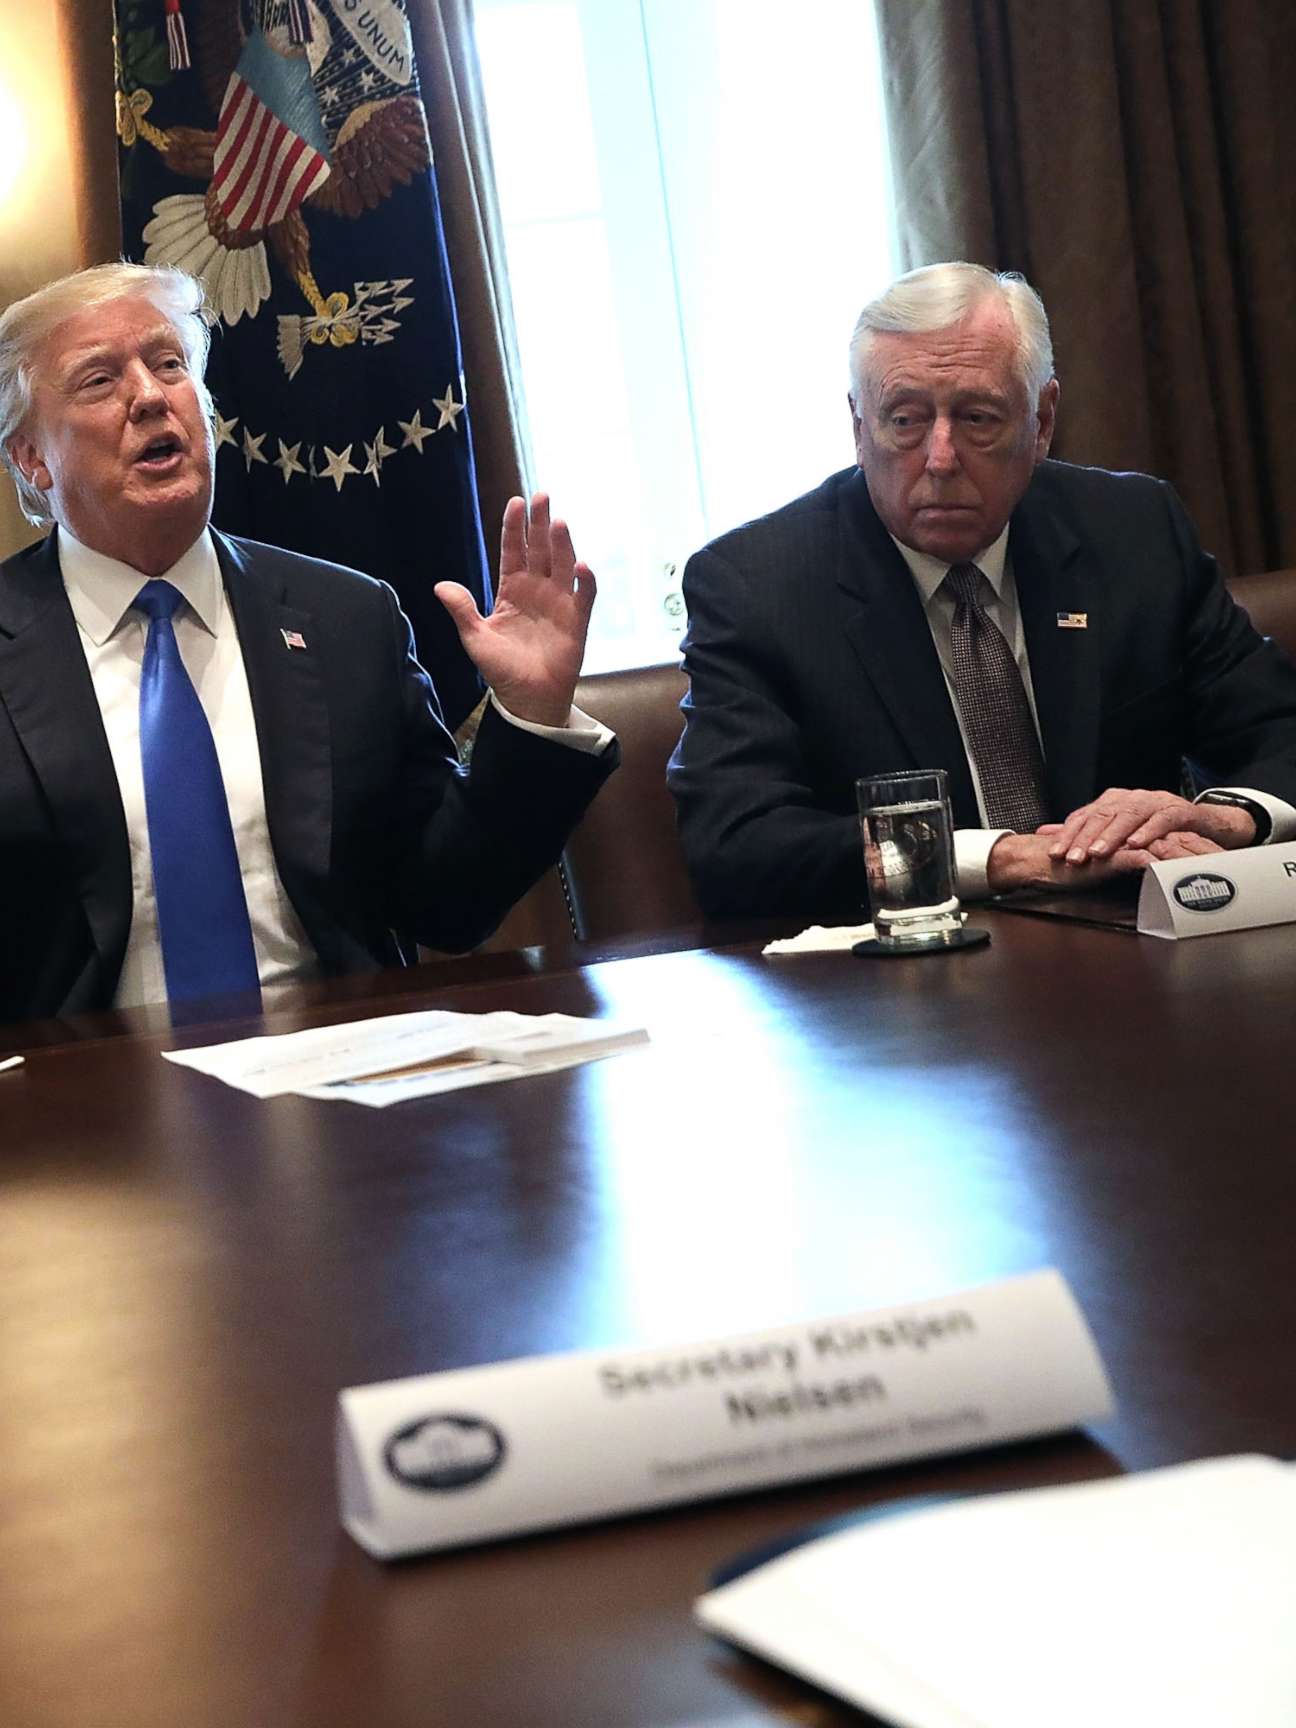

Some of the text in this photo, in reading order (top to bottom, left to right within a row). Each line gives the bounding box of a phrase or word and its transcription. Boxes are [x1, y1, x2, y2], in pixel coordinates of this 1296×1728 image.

[357, 10, 405, 73] UNUM
[599, 1310, 975, 1397] Secretary Kirstjen
[724, 1374, 888, 1424] Nielsen
